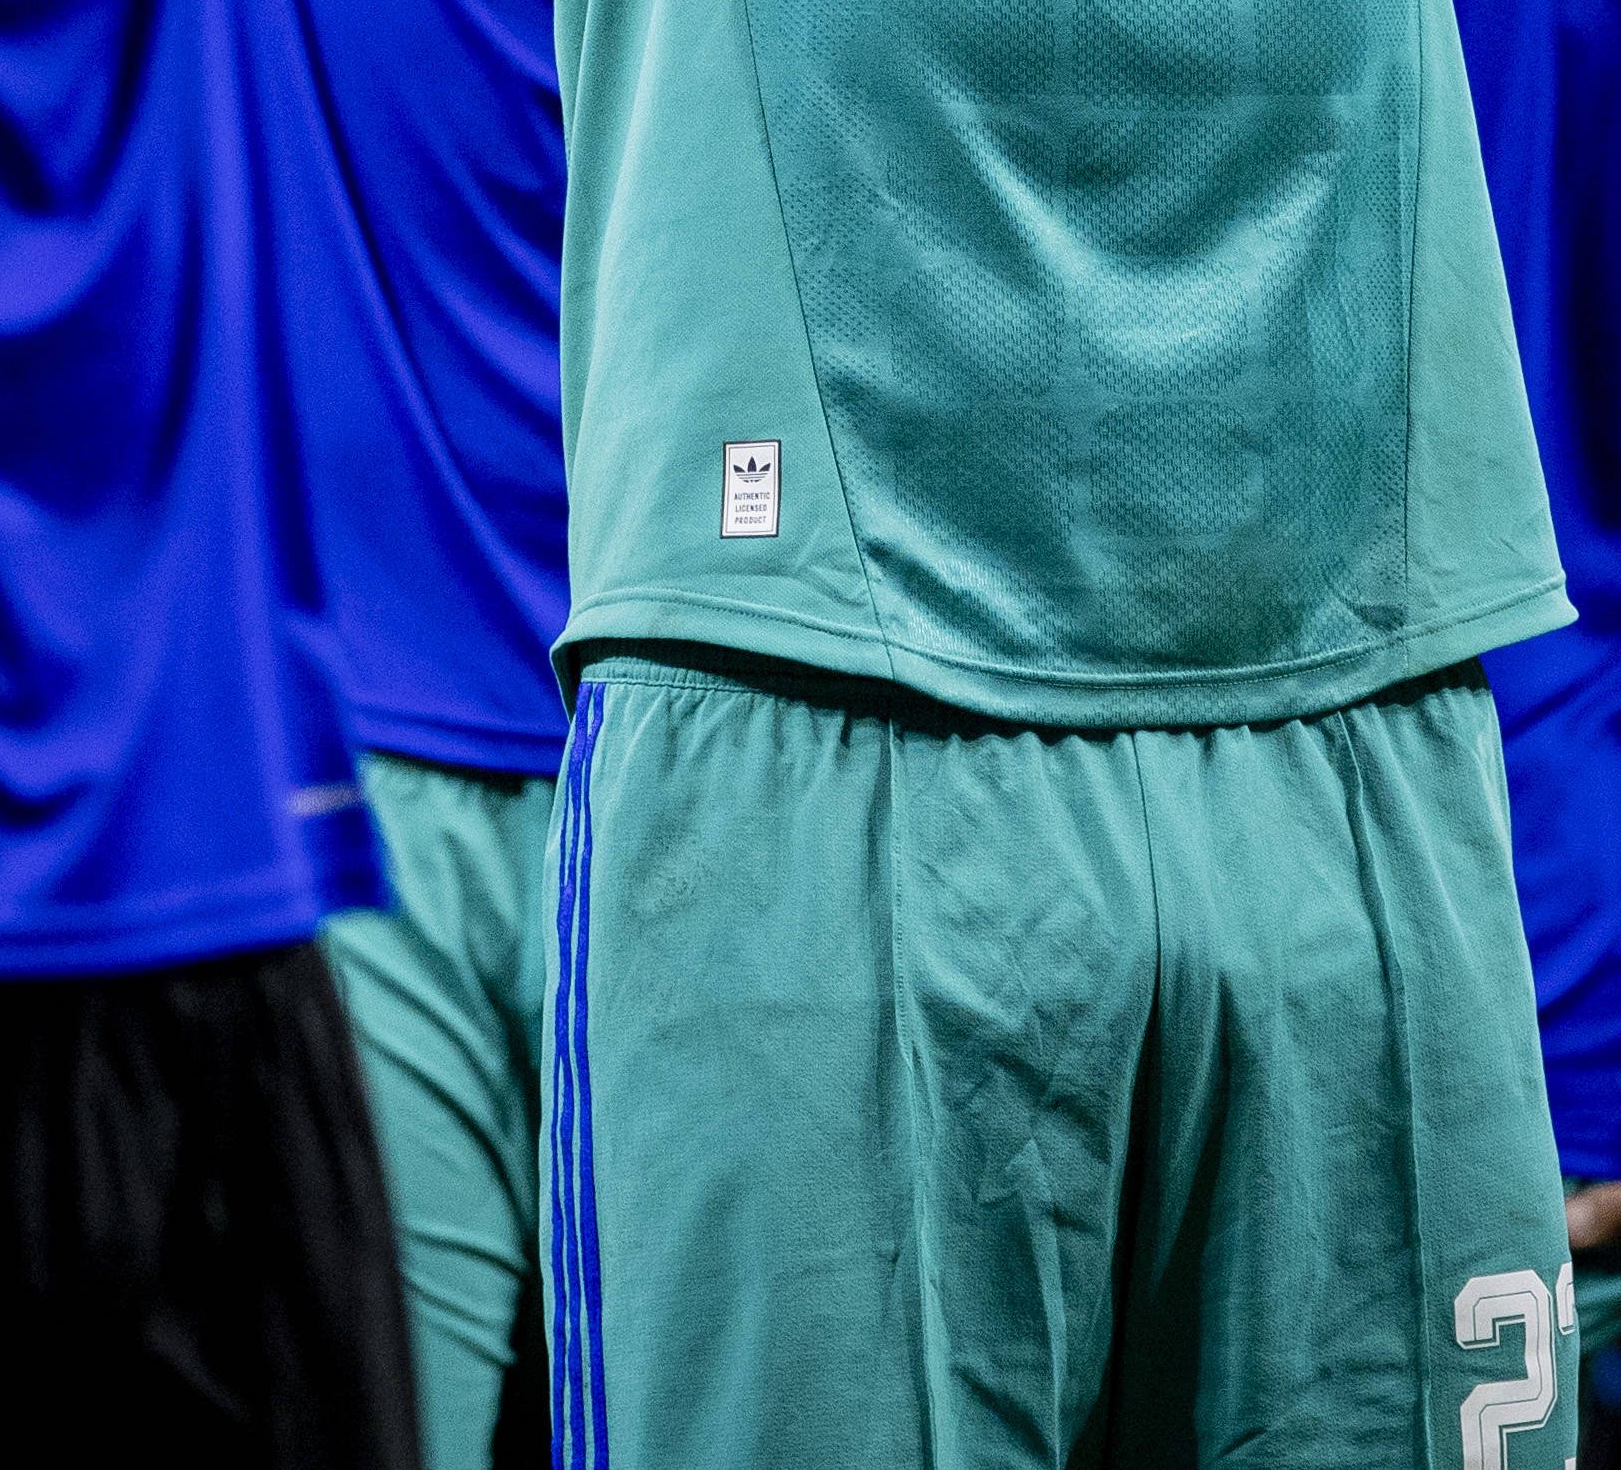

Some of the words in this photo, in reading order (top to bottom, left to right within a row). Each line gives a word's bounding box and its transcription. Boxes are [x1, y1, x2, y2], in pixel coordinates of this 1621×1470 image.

[734, 491, 770, 501] AUTHENTIC
[735, 503, 768, 513] LICENSED
[734, 515, 767, 525] PRODUCT
